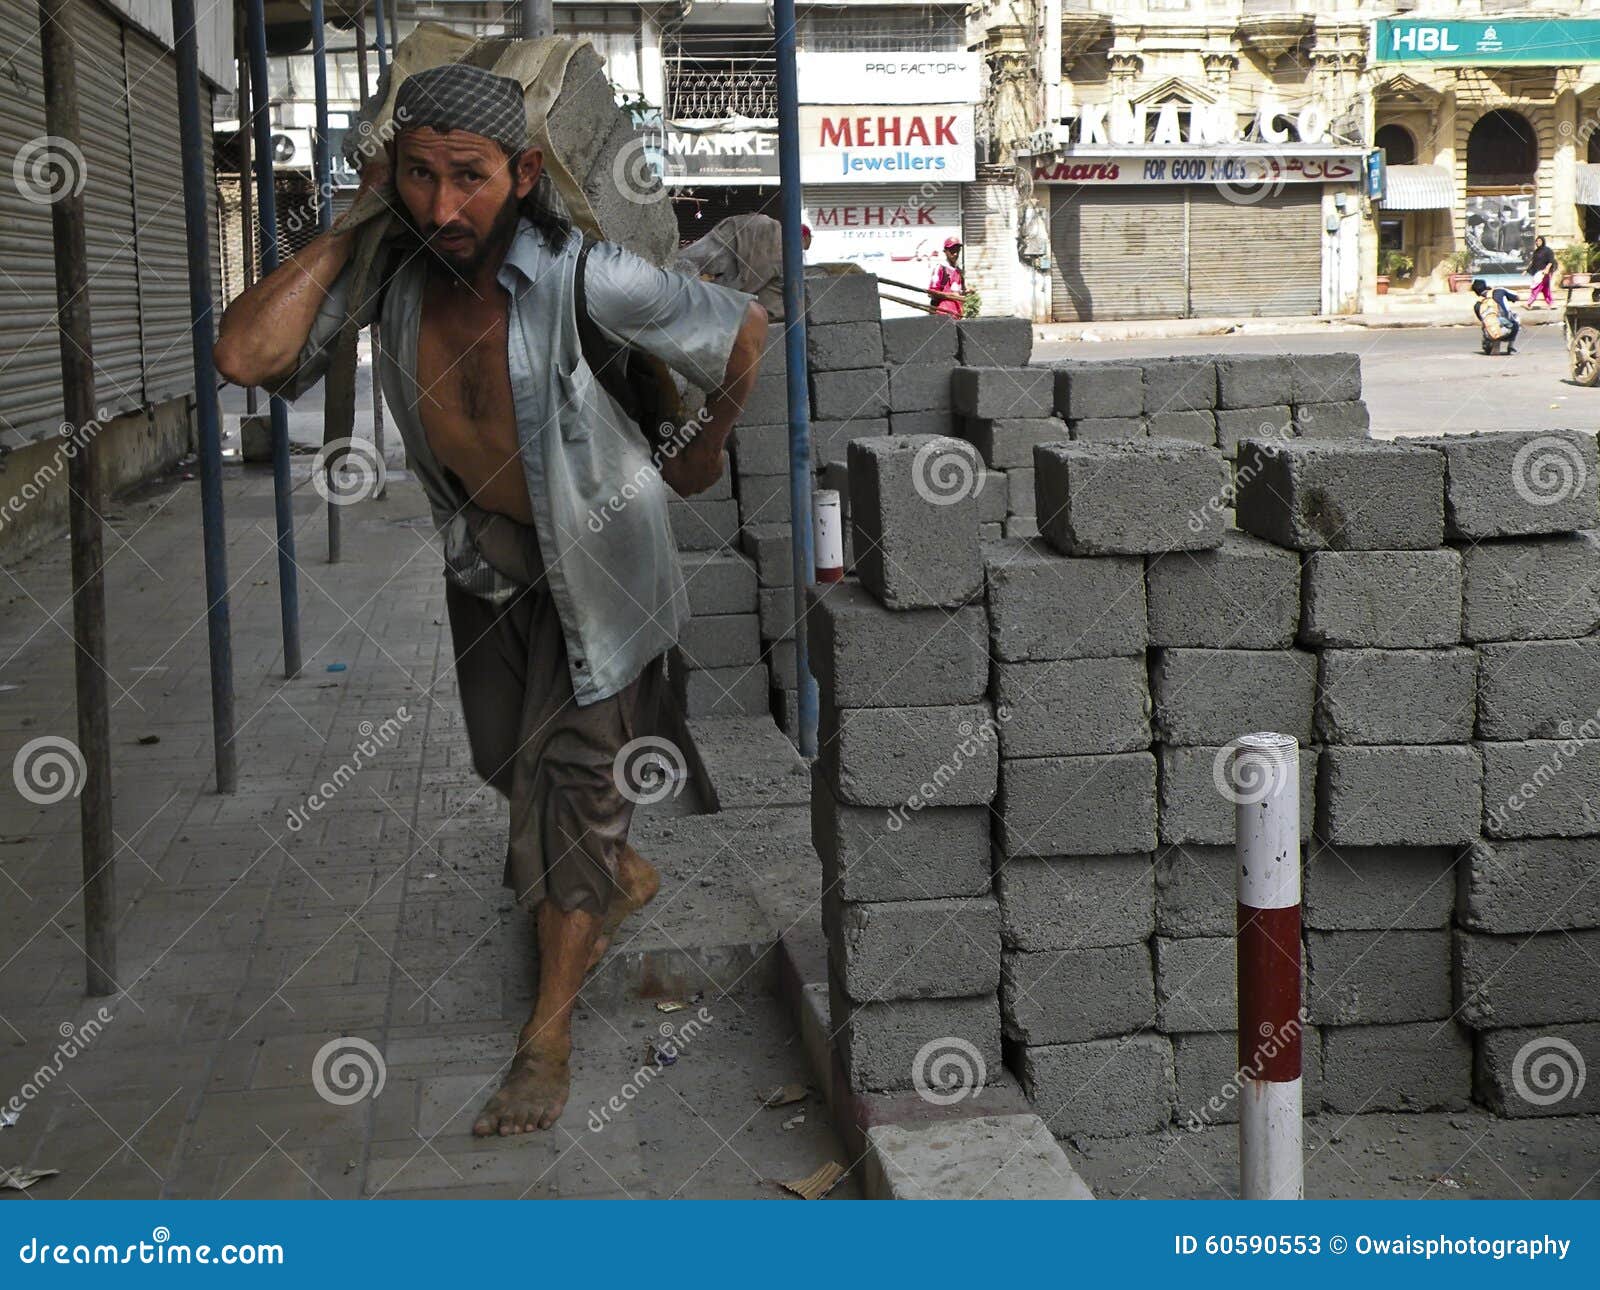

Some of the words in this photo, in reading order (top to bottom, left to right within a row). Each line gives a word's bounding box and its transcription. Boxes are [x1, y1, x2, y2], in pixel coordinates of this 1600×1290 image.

[1393, 28, 1460, 51] HBL
[865, 63, 897, 75] PRO
[900, 63, 968, 75] FACTORY
[820, 115, 959, 148] MEHAK
[842, 152, 946, 176] Jewellers
[1143, 159, 1165, 181] FOR
[1171, 159, 1206, 181] GOOD
[1210, 158, 1246, 181] SHOES
[816, 206, 937, 227] MEHAK
